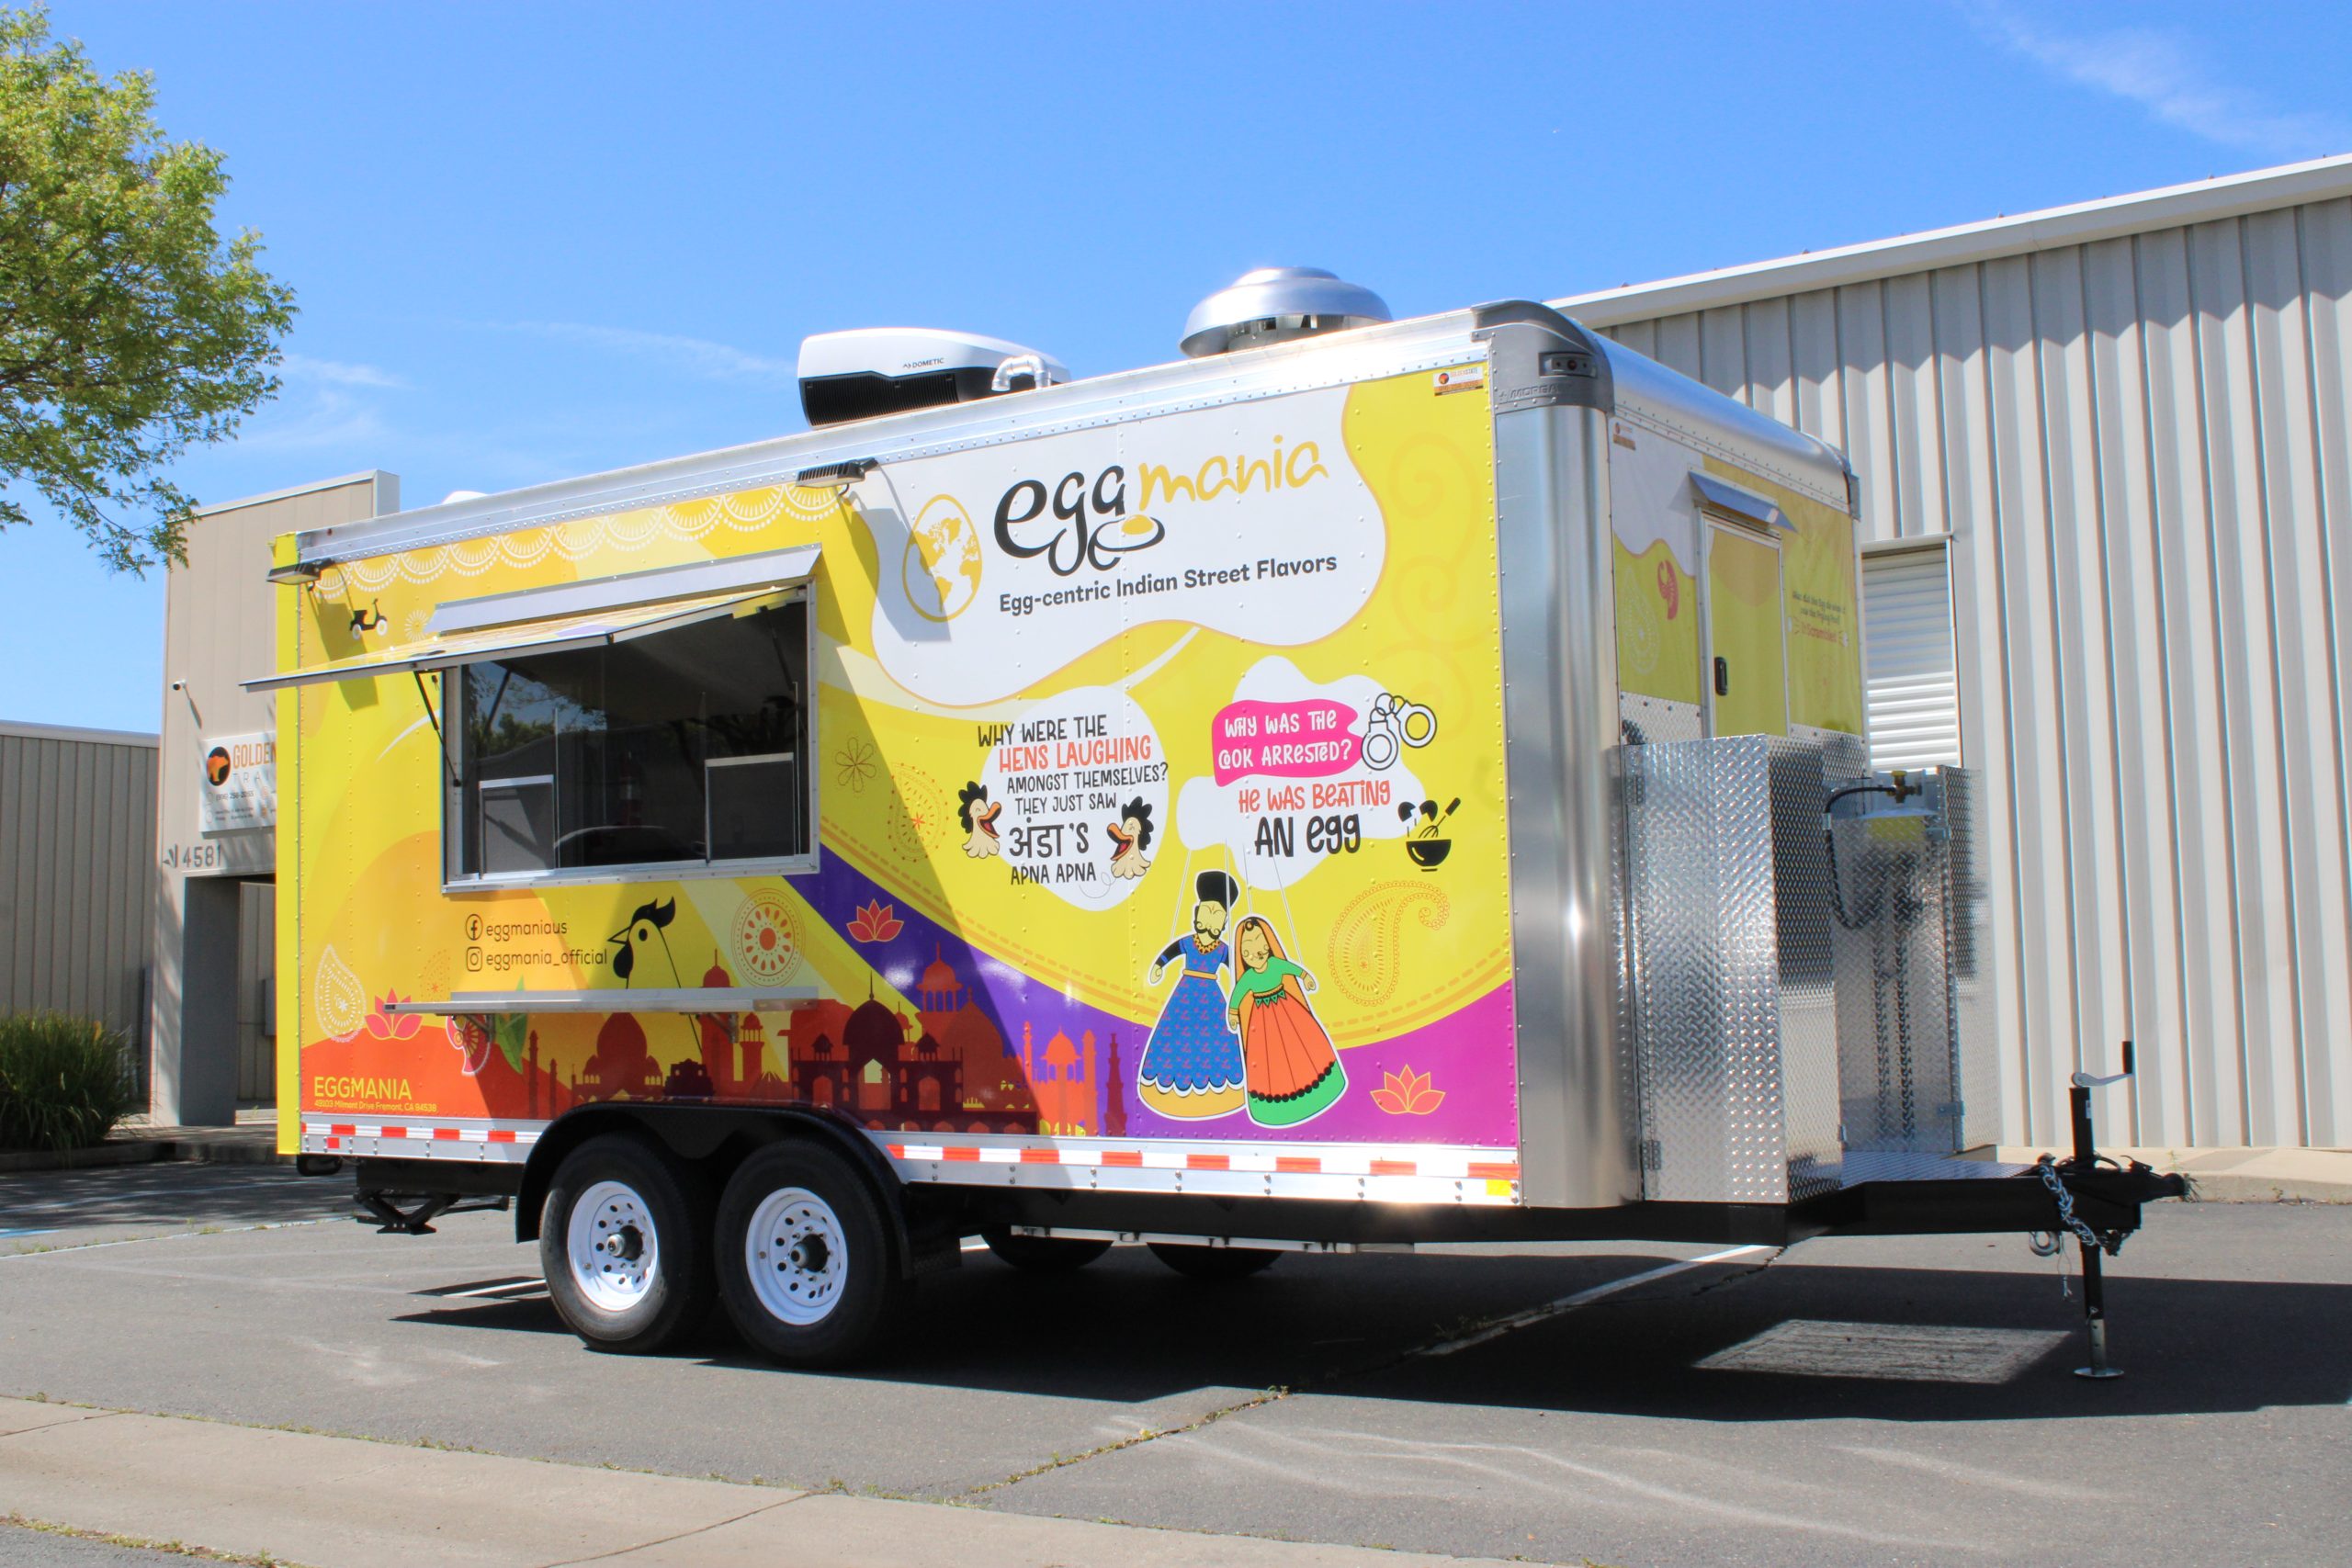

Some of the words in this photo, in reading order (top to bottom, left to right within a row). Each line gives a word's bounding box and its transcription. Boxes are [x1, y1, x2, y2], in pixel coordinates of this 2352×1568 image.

[911, 357, 945, 368] DOMETIC
[1000, 581, 1111, 616] Egg-centric
[1117, 573, 1178, 597] Indian
[1184, 564, 1250, 588] Street
[1257, 557, 1338, 580] Flavors
[978, 723, 1014, 747] WHY
[1022, 718, 1068, 741] WERE
[1073, 714, 1107, 739] THE
[1225, 716, 1257, 738] WHY
[1265, 713, 1300, 735] WAS
[999, 744, 1048, 773] HENS
[1057, 735, 1151, 769] LAUGHING
[1007, 773, 1069, 795] AMONGST
[1074, 761, 1169, 789] THEMSELVES?
[1015, 796, 1047, 816] THEY
[1052, 794, 1084, 812] JUST
[1089, 793, 1116, 810] SAW
[1267, 784, 1306, 811] WAS
[1254, 817, 1294, 858] AN
[1306, 814, 1361, 855] egg
[183, 845, 221, 868] 4581
[1011, 864, 1050, 886] APNA
[1056, 862, 1096, 884] APNA
[486, 919, 568, 942] eggmaniaus
[486, 948, 607, 971] eggmania_official
[314, 1077, 413, 1100] EGGMANIA
[358, 1101, 375, 1110] Drive
[375, 1101, 403, 1111] Fremont,
[404, 1102, 413, 1111] CA
[414, 1103, 437, 1112] 94538
